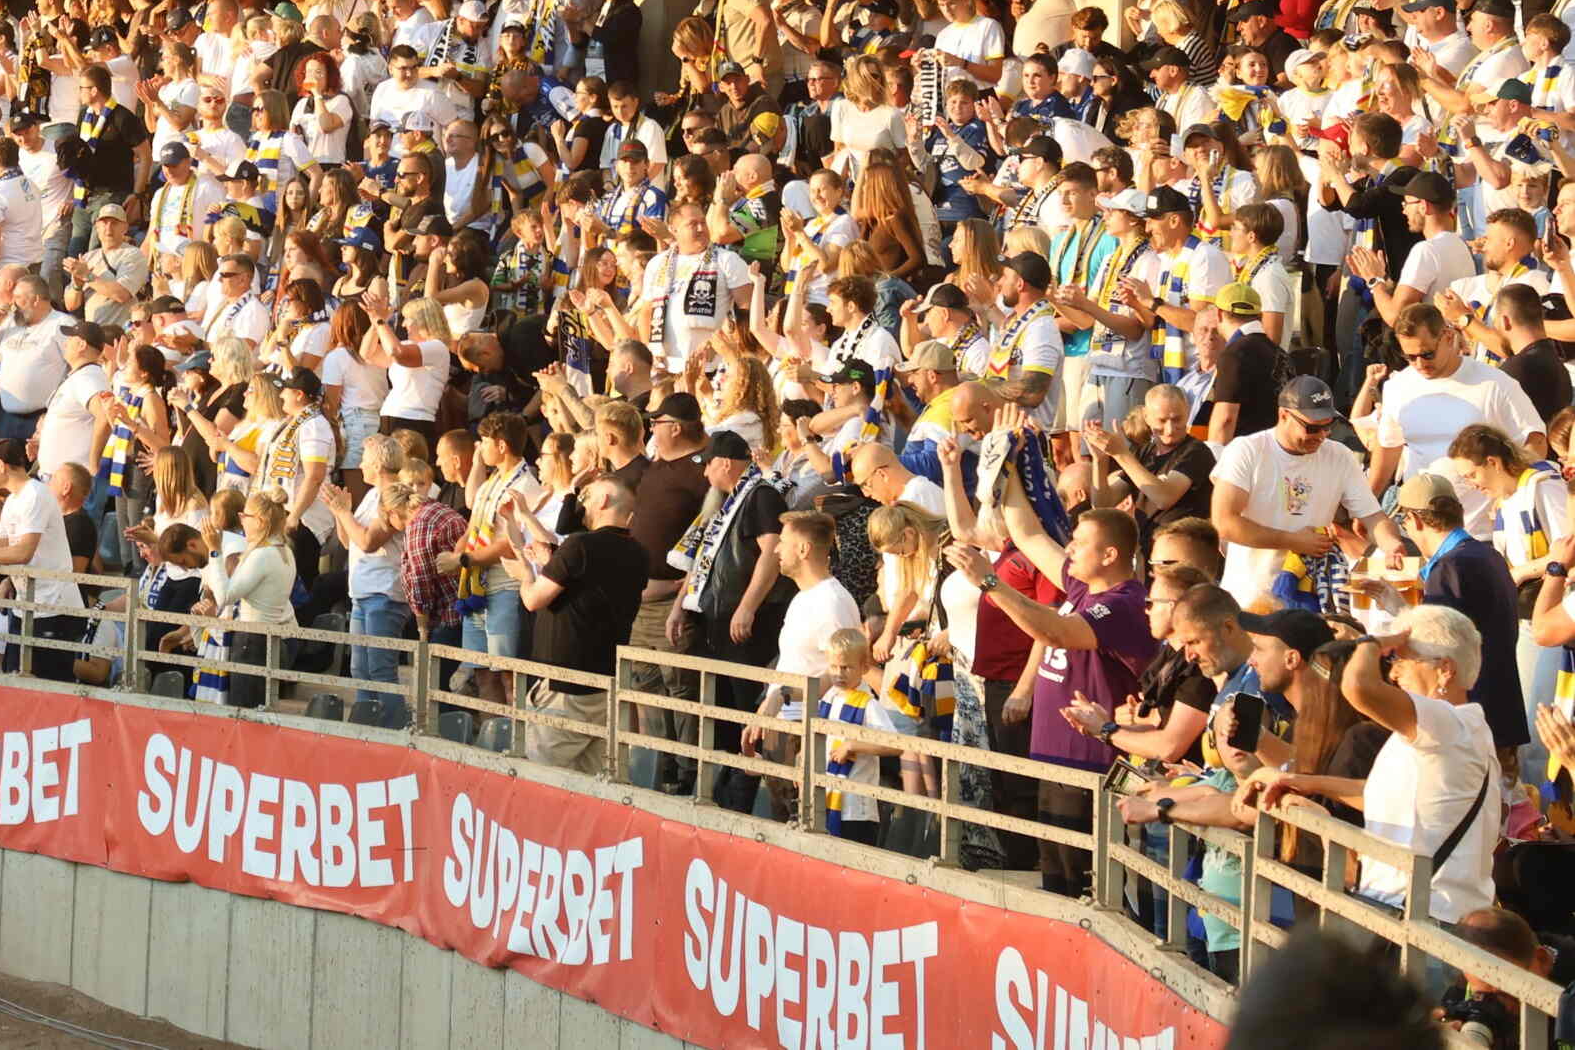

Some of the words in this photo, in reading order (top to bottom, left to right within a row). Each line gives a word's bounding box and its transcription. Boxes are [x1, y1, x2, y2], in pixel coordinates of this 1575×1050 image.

[137, 732, 420, 888] SUPERBET
[443, 791, 645, 966] SUPERBET
[683, 857, 938, 1050] SUPERBET
